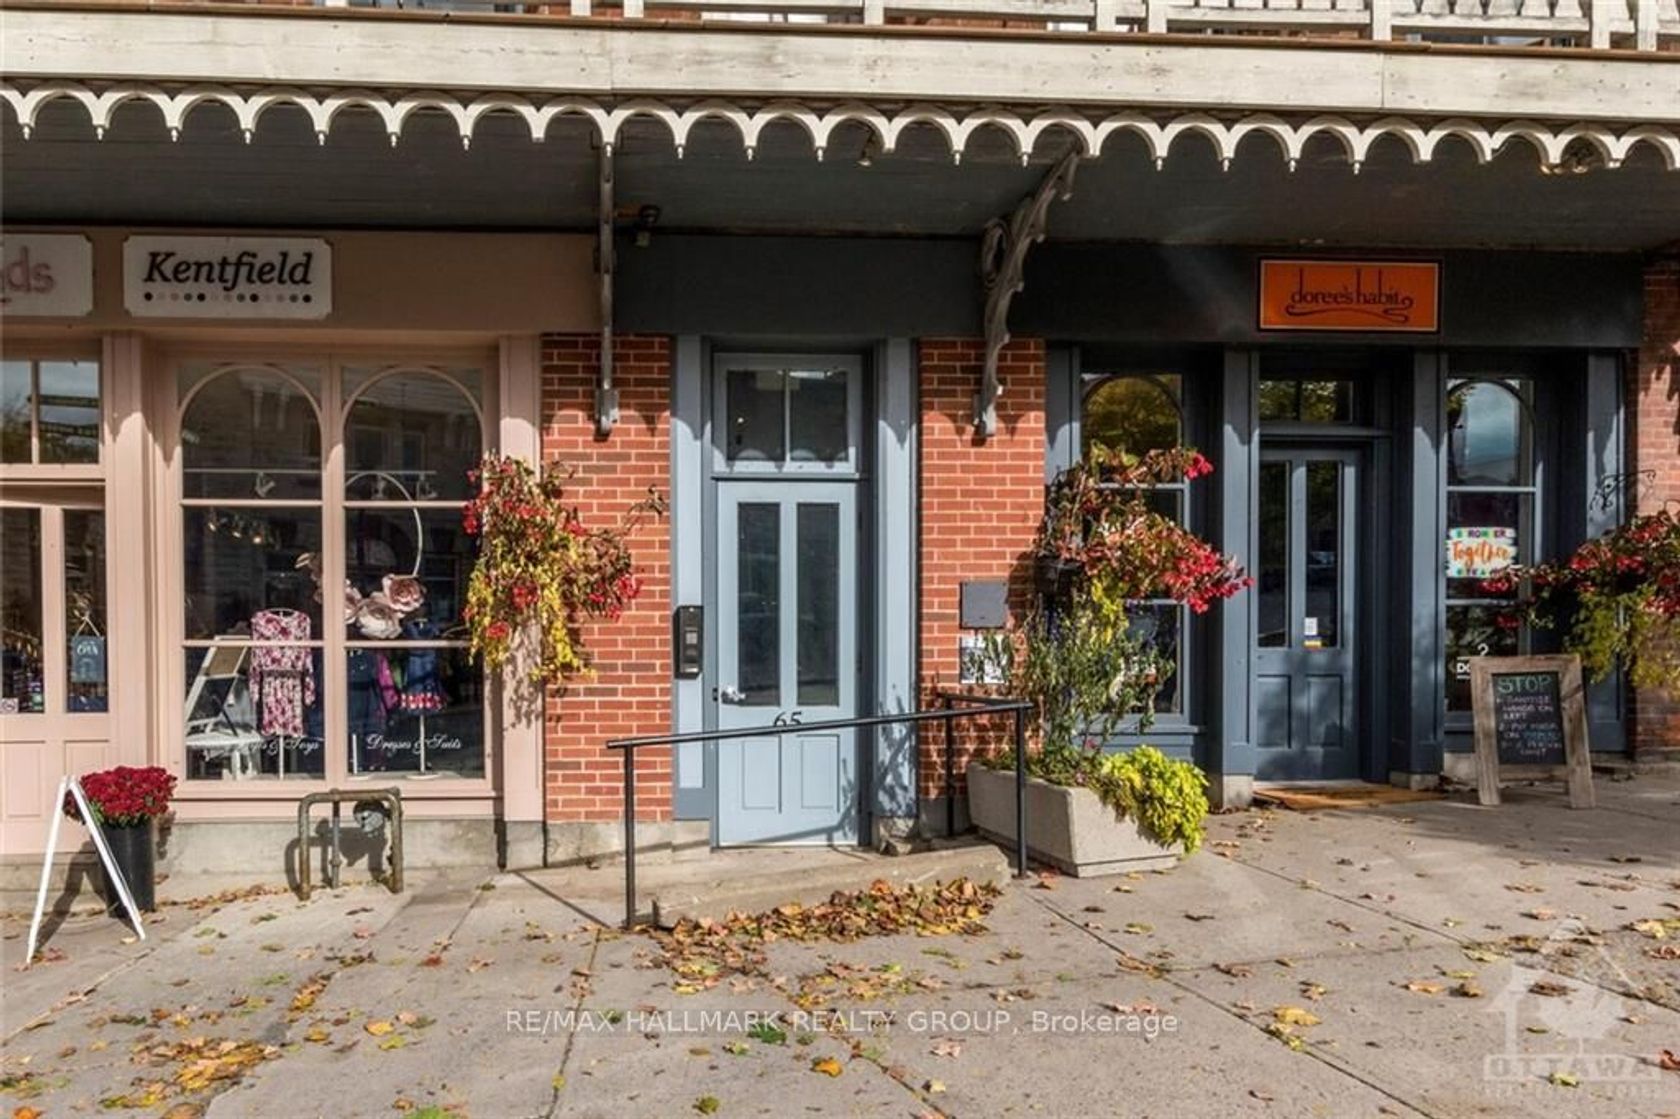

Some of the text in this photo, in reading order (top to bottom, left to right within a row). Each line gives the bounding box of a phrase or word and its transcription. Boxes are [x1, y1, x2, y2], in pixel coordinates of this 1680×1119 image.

[144, 252, 313, 291] Kentfield
[1497, 675, 1552, 693] STOP
[774, 711, 802, 727] 65
